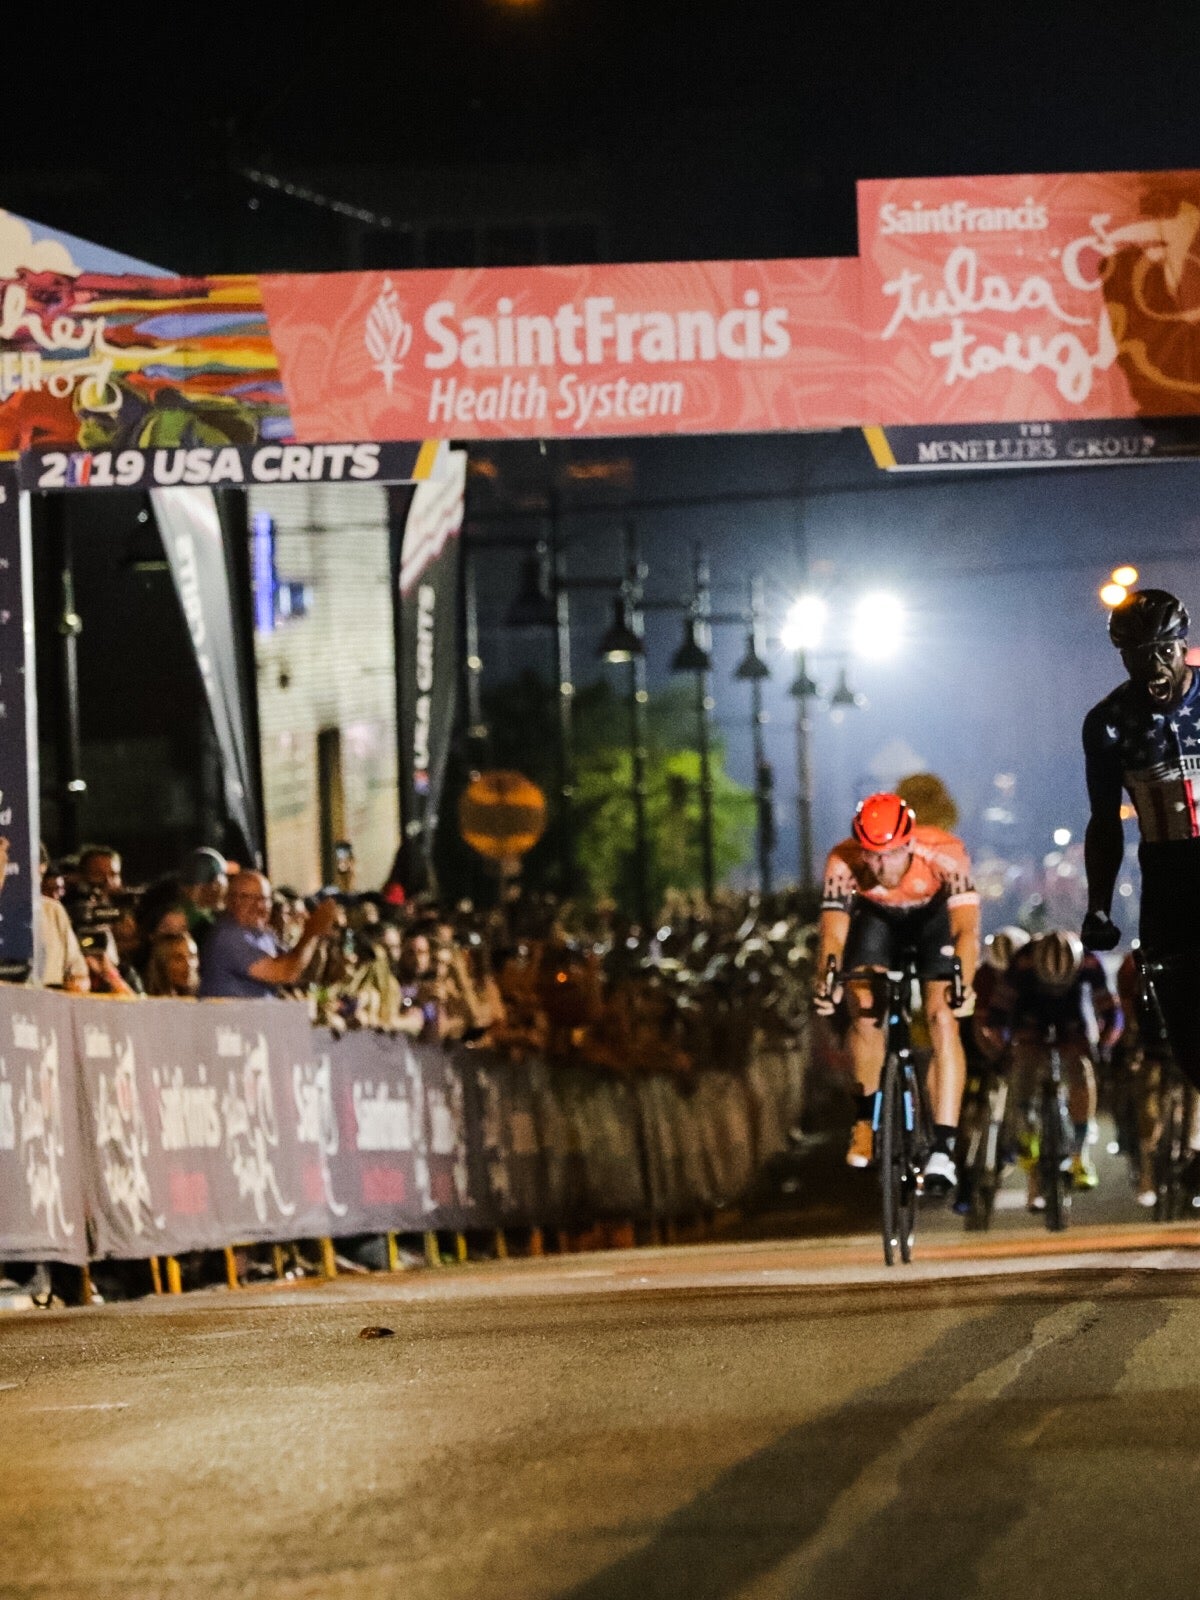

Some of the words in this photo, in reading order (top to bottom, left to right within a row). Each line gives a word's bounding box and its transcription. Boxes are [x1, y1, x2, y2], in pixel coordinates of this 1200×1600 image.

[878, 196, 1049, 237] SaintFrancis
[880, 246, 1093, 341] tulsa
[423, 288, 792, 369] SaintFrancis
[427, 374, 547, 424] Health
[555, 373, 684, 431] System
[152, 449, 245, 486] USA
[251, 444, 382, 484] CRITS
[1066, 434, 1156, 459] GROUP
